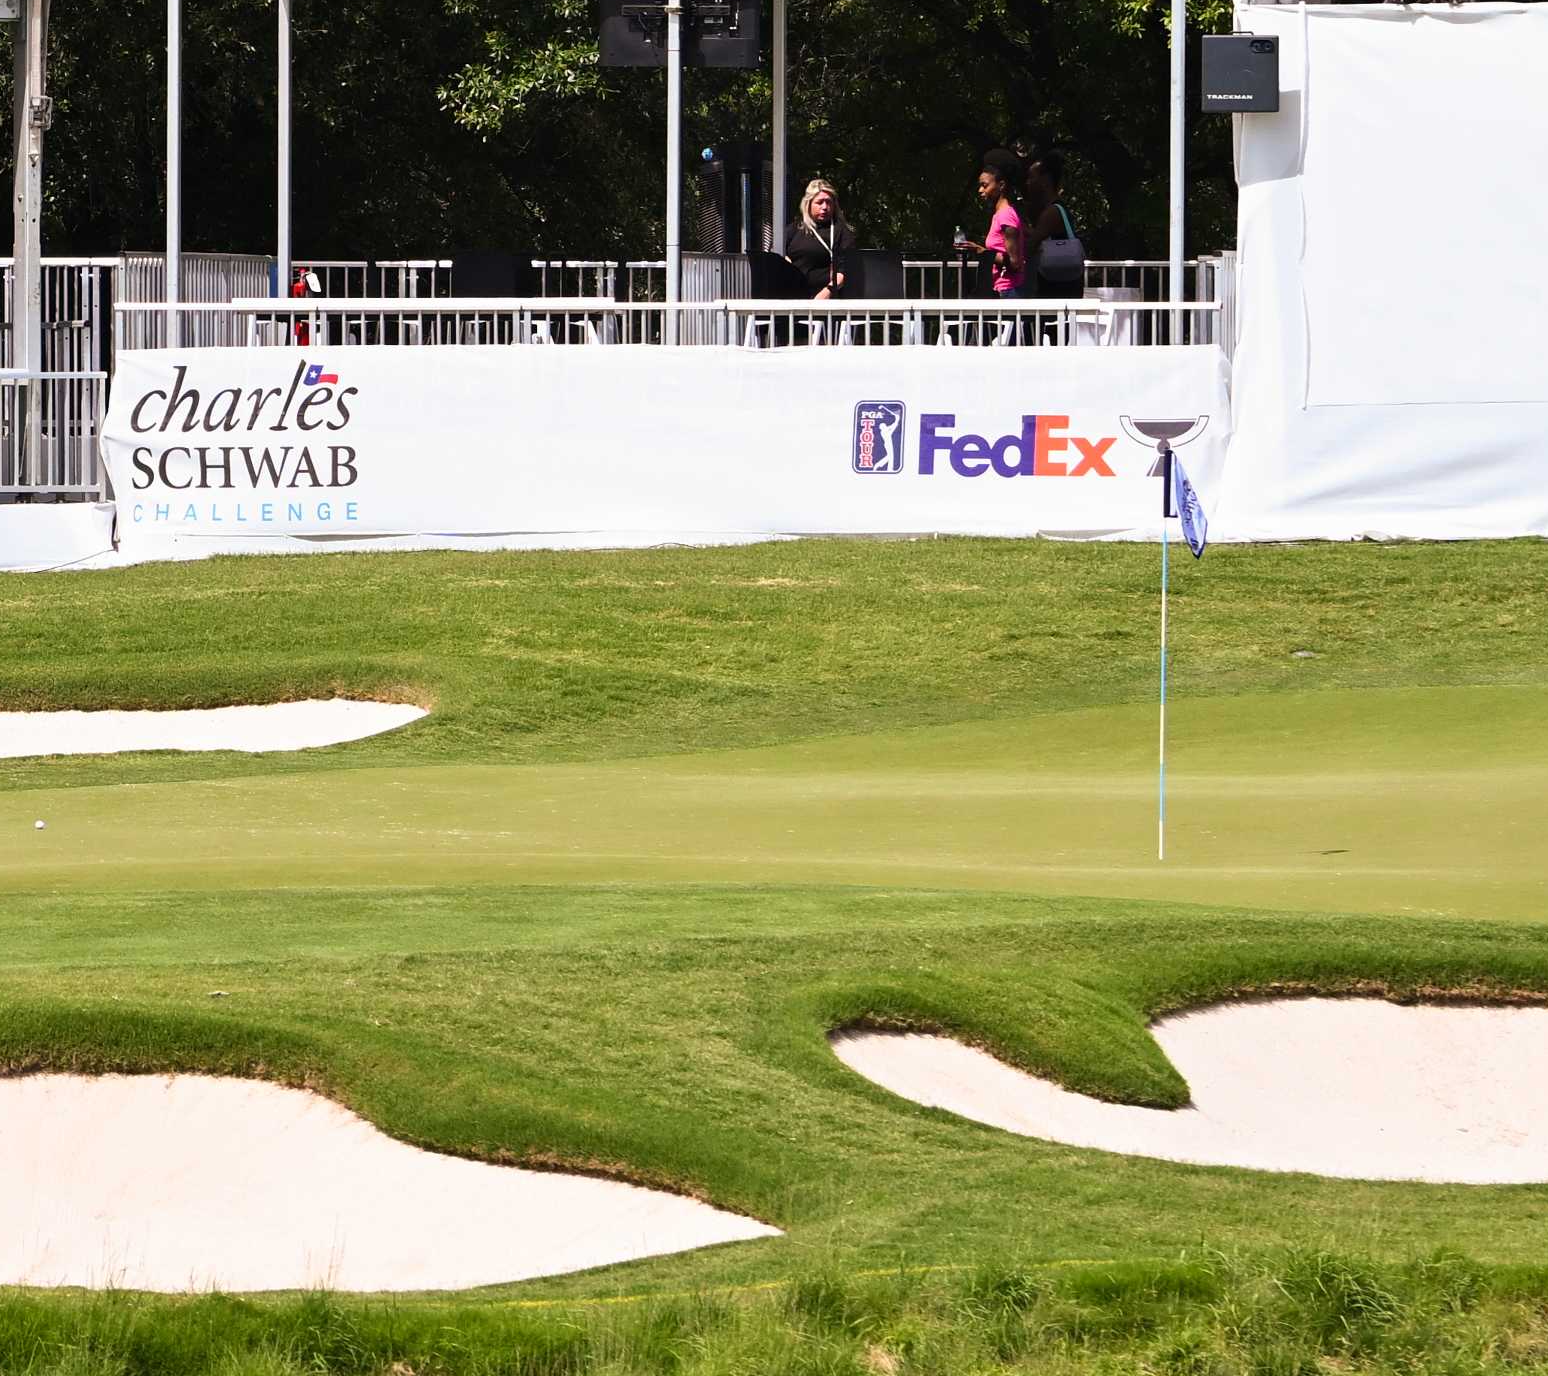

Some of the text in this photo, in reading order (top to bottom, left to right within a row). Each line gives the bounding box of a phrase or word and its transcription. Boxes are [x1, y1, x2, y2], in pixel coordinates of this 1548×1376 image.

[130, 359, 358, 432] charles
[131, 446, 358, 489] SCHWAB
[859, 419, 875, 468] TOUR
[918, 413, 1118, 478] FedEx
[133, 502, 358, 522] CHALLENGE
